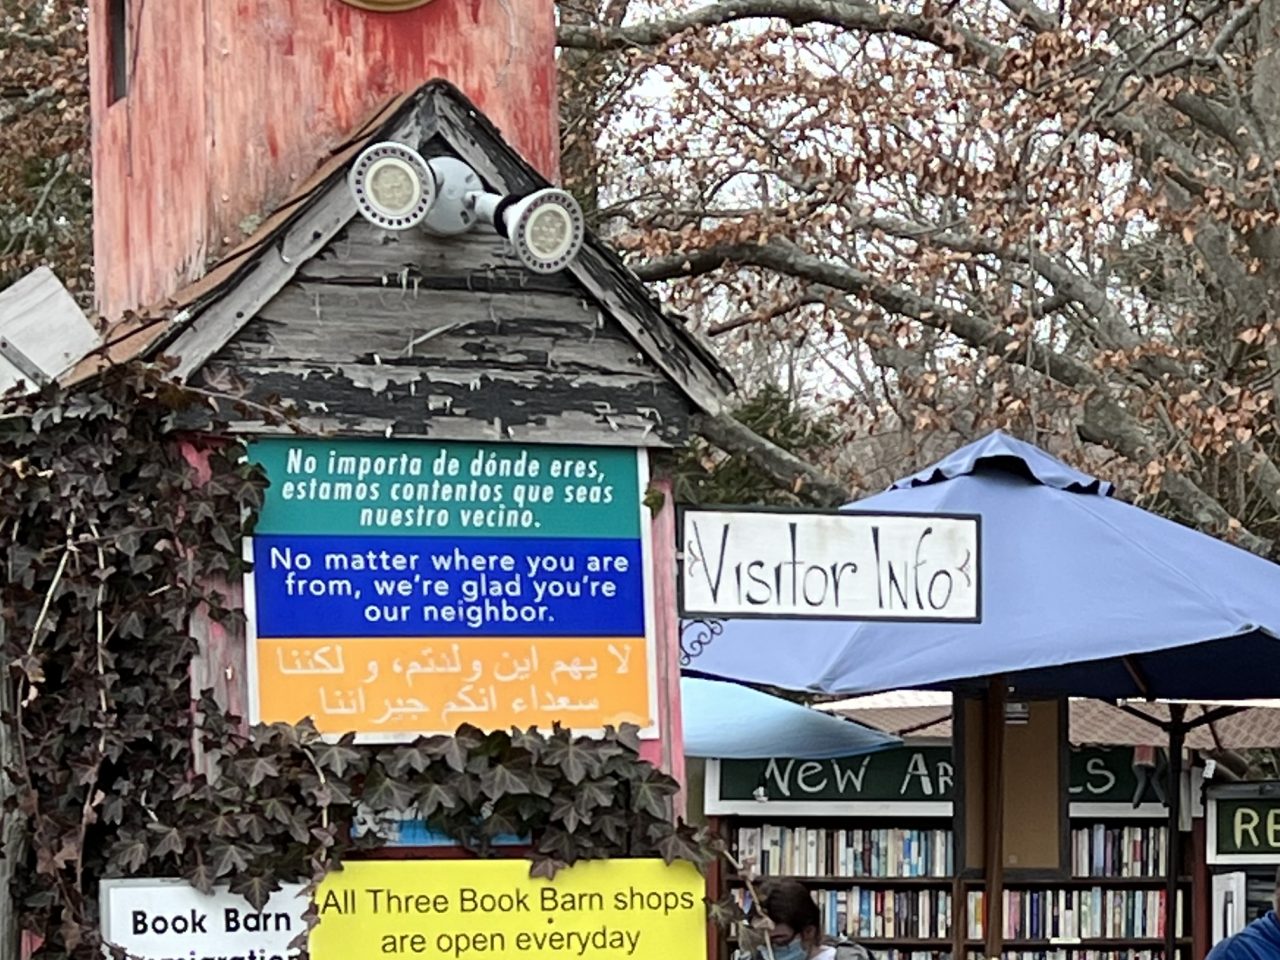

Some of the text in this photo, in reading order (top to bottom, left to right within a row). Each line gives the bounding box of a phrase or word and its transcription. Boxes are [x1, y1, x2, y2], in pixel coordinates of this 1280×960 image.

[286, 447, 605, 484] No importa de dónde eres,
[281, 477, 614, 509] estamos contentos que seas
[360, 502, 542, 528] nuestro vecino.
[269, 546, 630, 578] No matter where you are
[691, 520, 858, 608] Visitor
[284, 570, 617, 603] from, we're glad you're
[363, 597, 555, 628] our neighbor.
[606, 642, 633, 675] لا
[320, 884, 695, 916] All Three Book Barn shops
[131, 907, 292, 935] Book Barn
[380, 925, 641, 959] are open everyday
